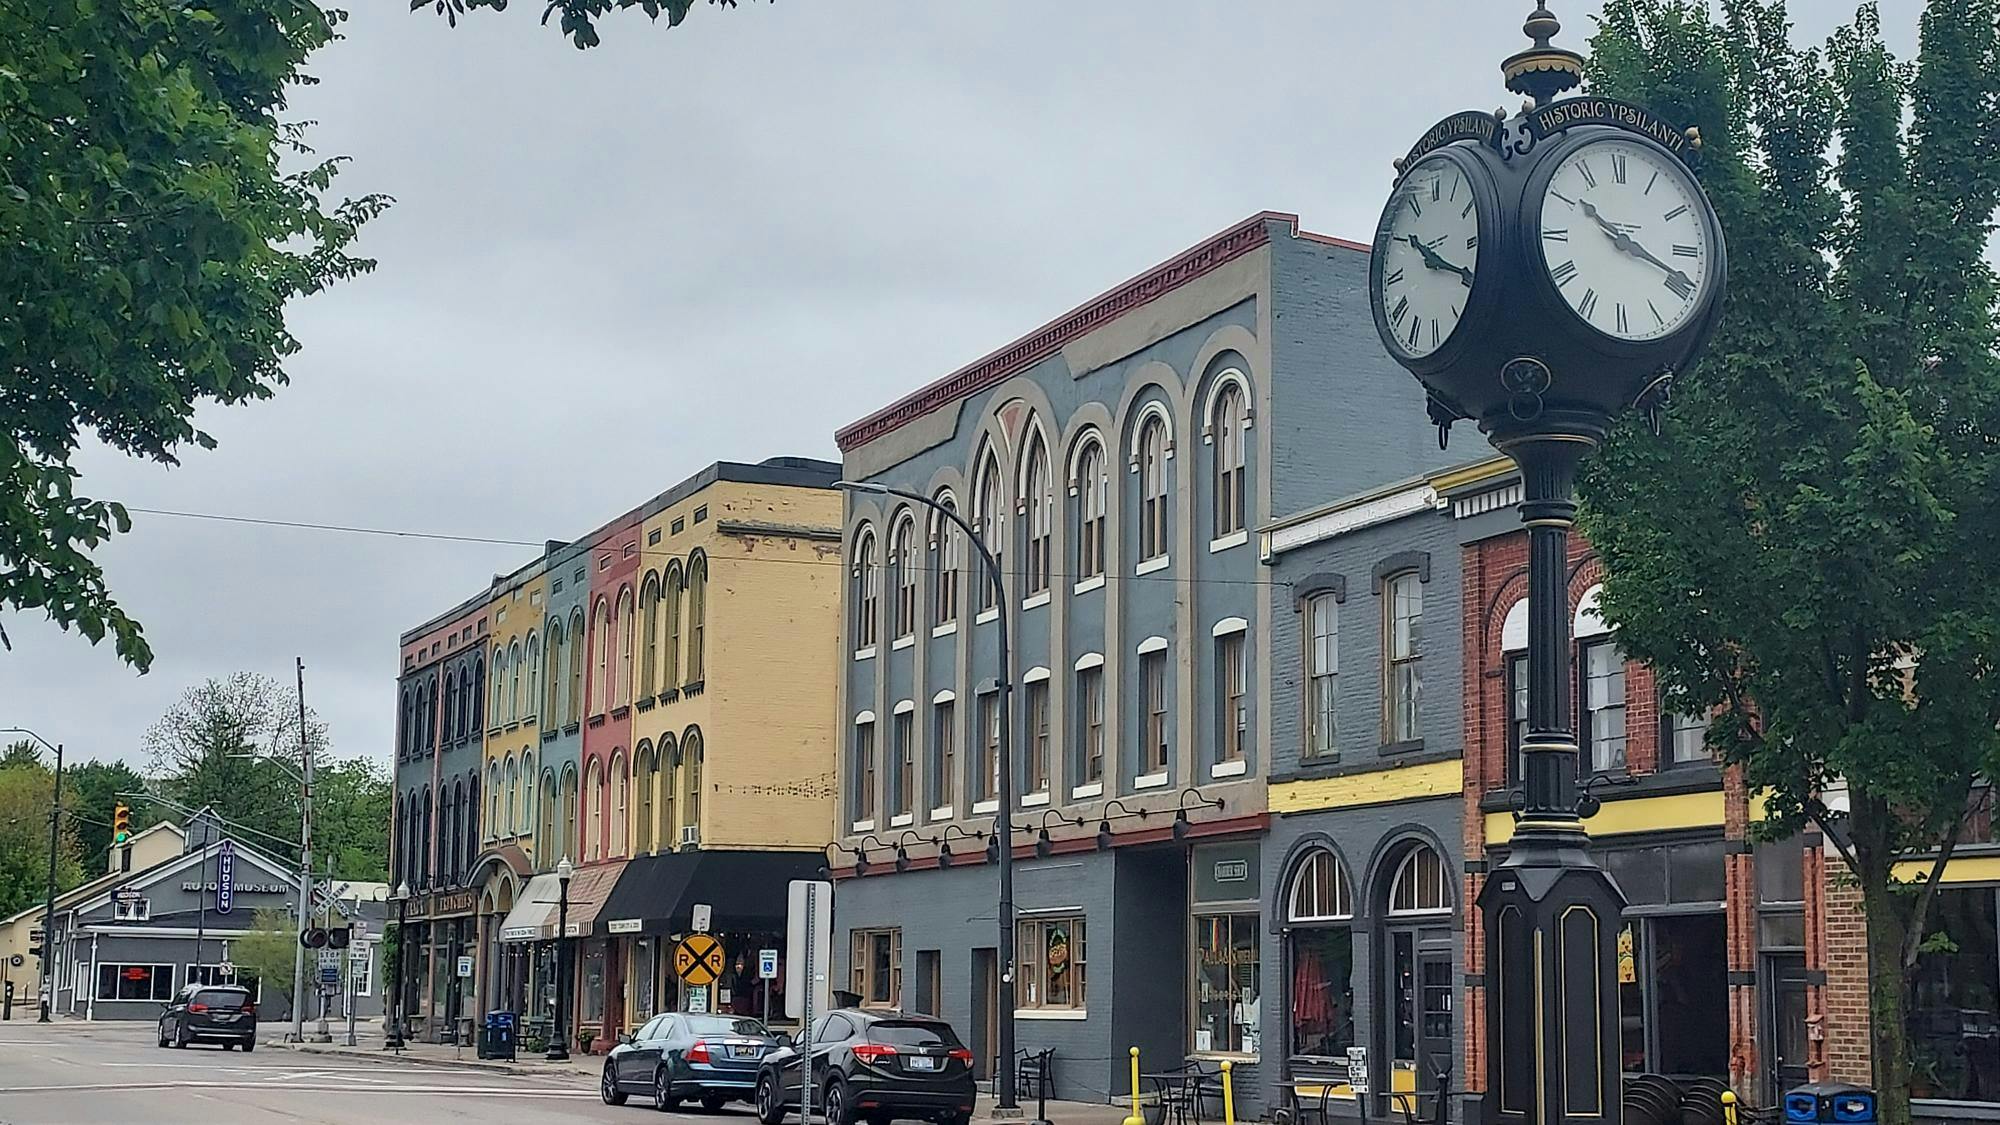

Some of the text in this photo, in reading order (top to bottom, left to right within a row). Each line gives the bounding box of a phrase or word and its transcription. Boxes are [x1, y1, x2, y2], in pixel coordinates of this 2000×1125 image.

[1539, 101, 1684, 152] HISTORIC YPSILANTI
[1401, 116, 1495, 173] HISTORIC YPSILANTI
[1611, 153, 1626, 184] XII
[1663, 203, 1688, 222] II
[1672, 244, 1698, 258] III
[182, 881, 289, 893] AUTO MUSEUM
[221, 856, 231, 908] HUDSON
[679, 954, 721, 967] R R
